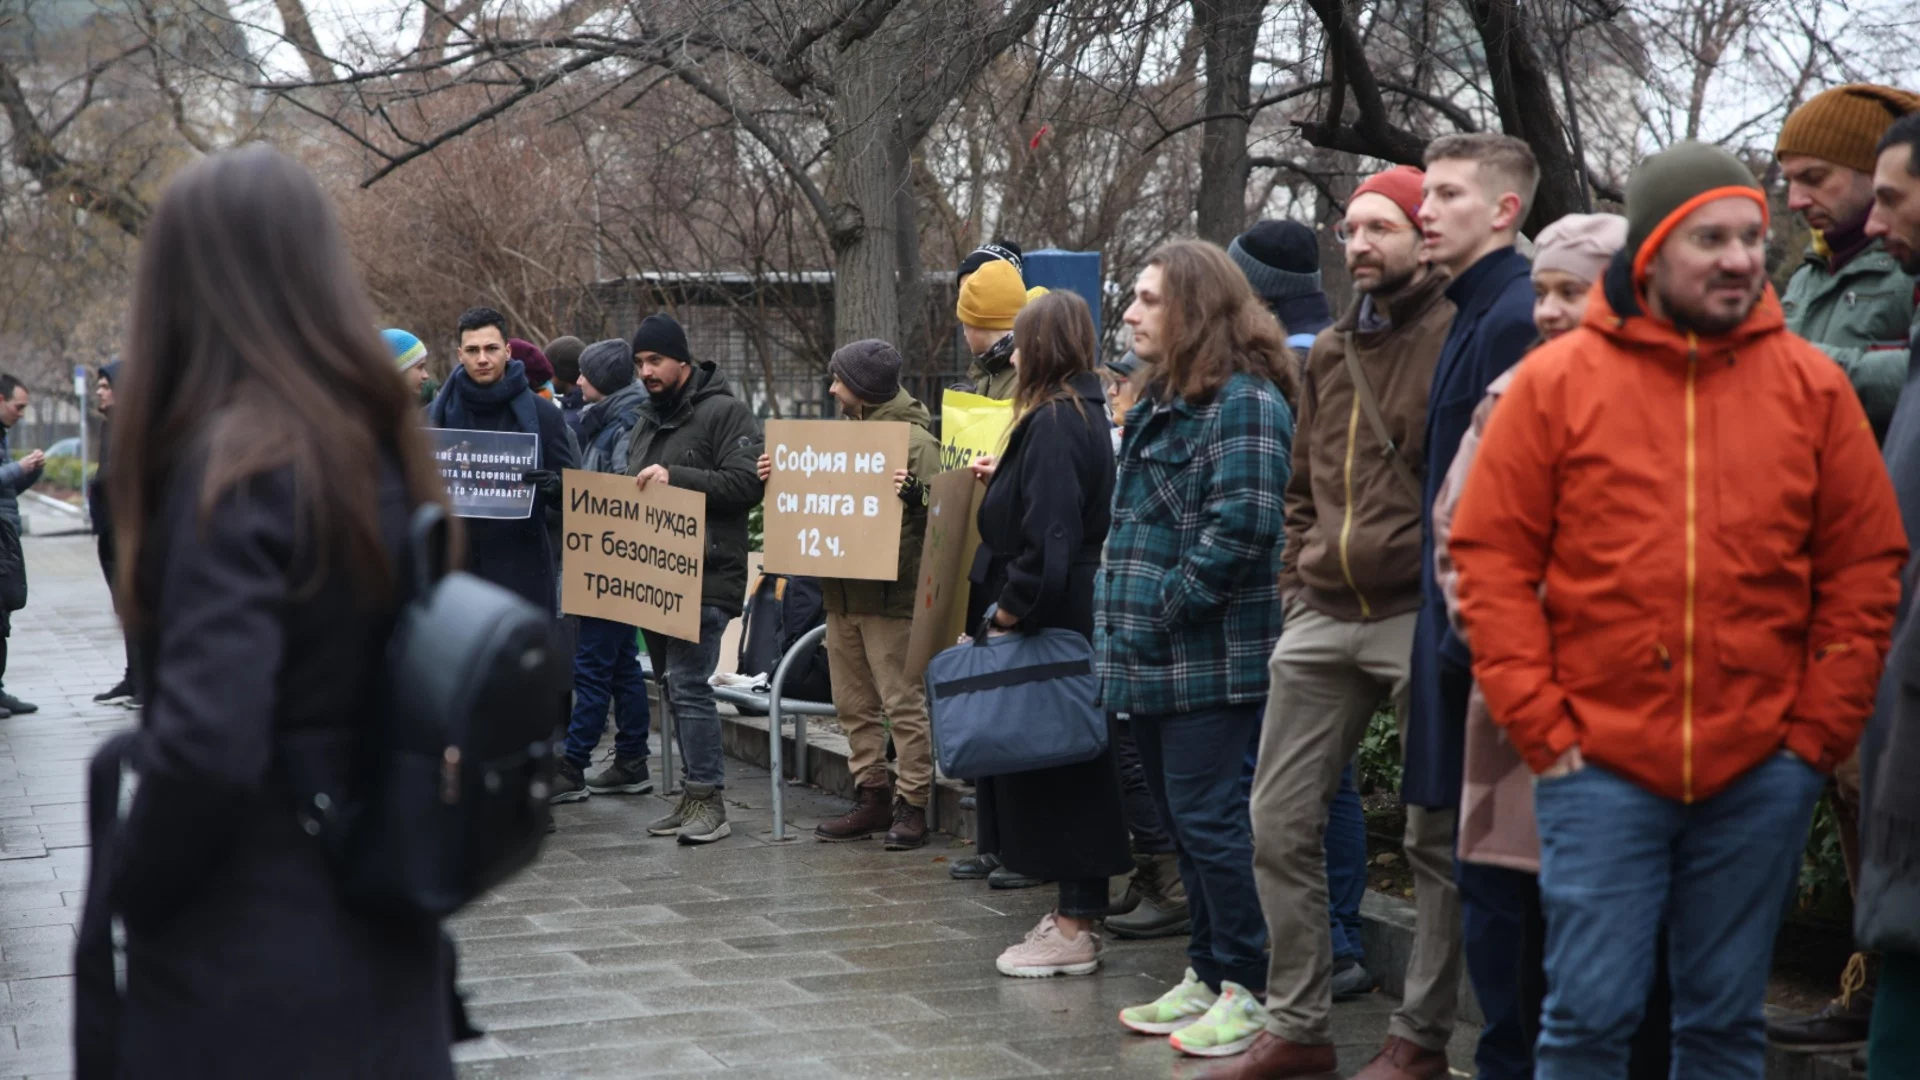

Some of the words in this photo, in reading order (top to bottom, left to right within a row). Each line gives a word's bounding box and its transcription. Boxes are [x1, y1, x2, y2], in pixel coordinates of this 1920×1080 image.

[455, 452, 468, 462] ДА
[470, 453, 532, 465] ПОДОБРЯВАТЕ
[775, 443, 848, 478] София
[854, 451, 886, 474] не
[461, 470, 472, 479] НА
[475, 471, 522, 482] СОФИЯНЦИ
[454, 487, 465, 496] ГО
[777, 491, 799, 513] си
[803, 492, 855, 516] ляга
[863, 495, 879, 517] в
[571, 487, 640, 521] Имам
[645, 505, 698, 539] нужда
[566, 531, 593, 552] от
[601, 530, 698, 577] безопасен
[797, 527, 821, 557] 12
[825, 535, 845, 557] ч.
[584, 572, 683, 615] транспорт
